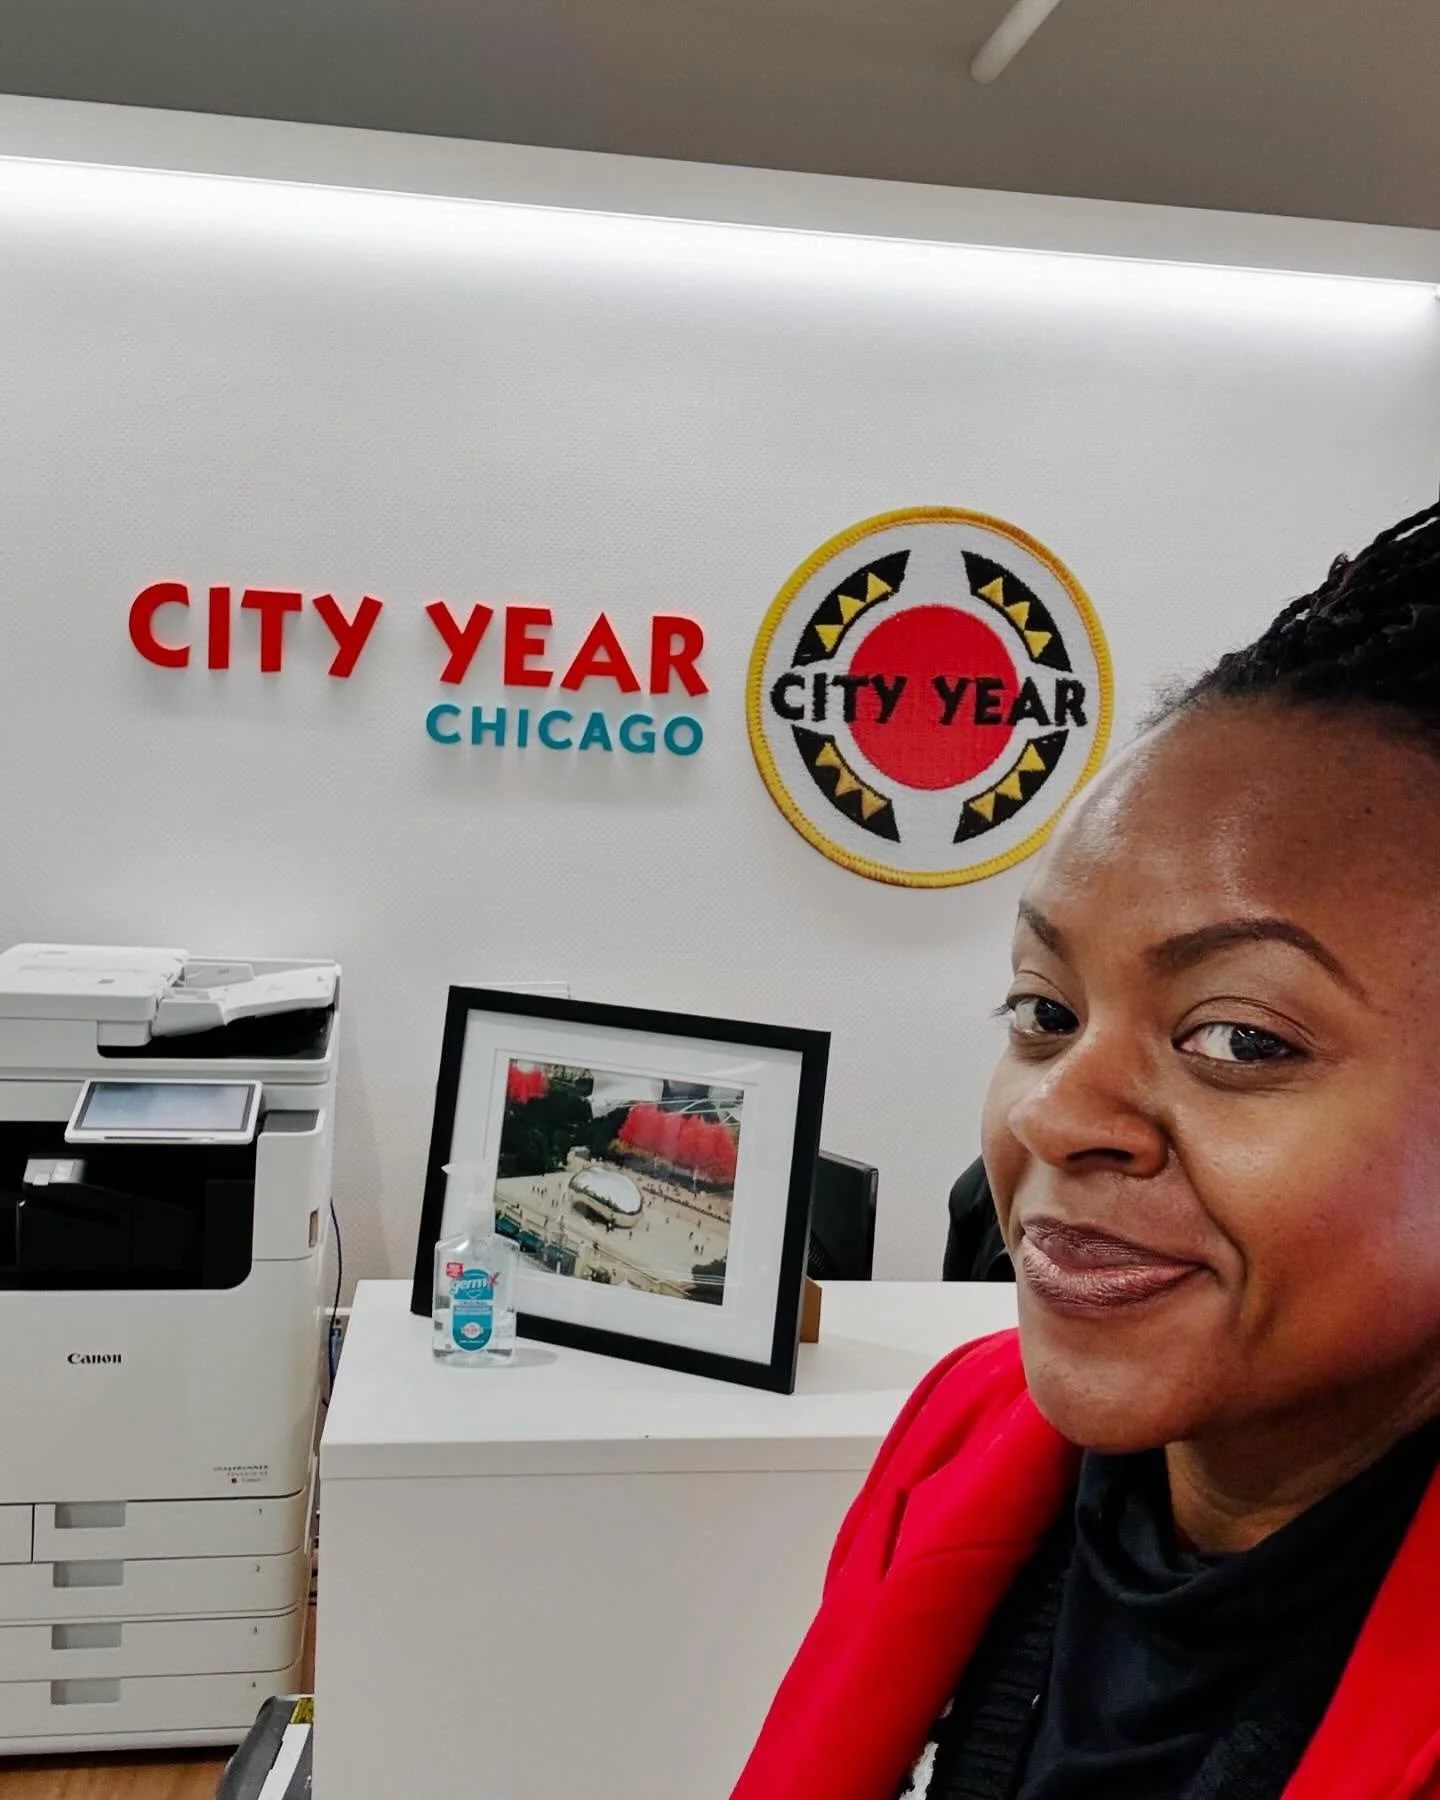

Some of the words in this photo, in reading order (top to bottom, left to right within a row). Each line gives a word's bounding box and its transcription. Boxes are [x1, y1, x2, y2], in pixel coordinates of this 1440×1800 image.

[128, 582, 383, 678] CITY
[425, 600, 709, 697] YEAR
[769, 671, 908, 724] CITY
[930, 674, 1088, 728] YEAR
[425, 703, 705, 757] CHICAGO
[67, 1353, 122, 1365] Canon
